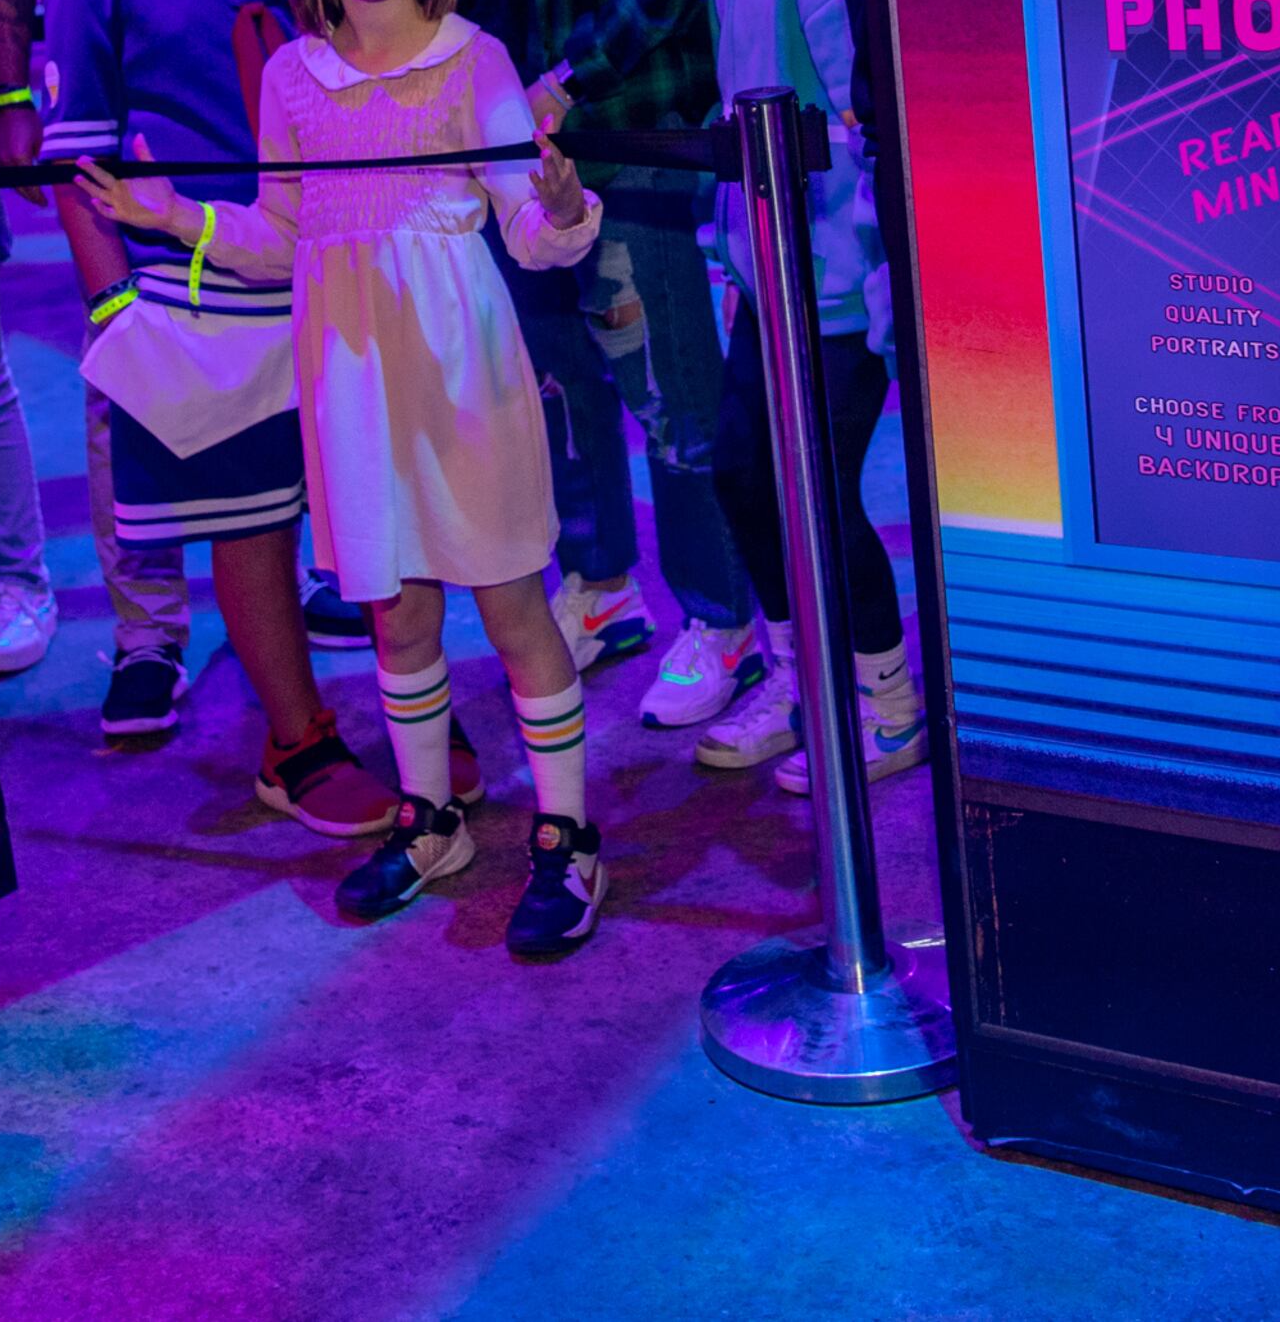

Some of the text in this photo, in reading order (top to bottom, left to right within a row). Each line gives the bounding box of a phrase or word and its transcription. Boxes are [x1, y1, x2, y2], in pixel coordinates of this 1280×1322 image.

[1169, 273, 1254, 295] STUDIO
[1165, 304, 1262, 327] QUALITY
[1151, 335, 1280, 360] PORTRAITS
[1135, 396, 1224, 420] CHOOSE
[1155, 425, 1174, 446] 4
